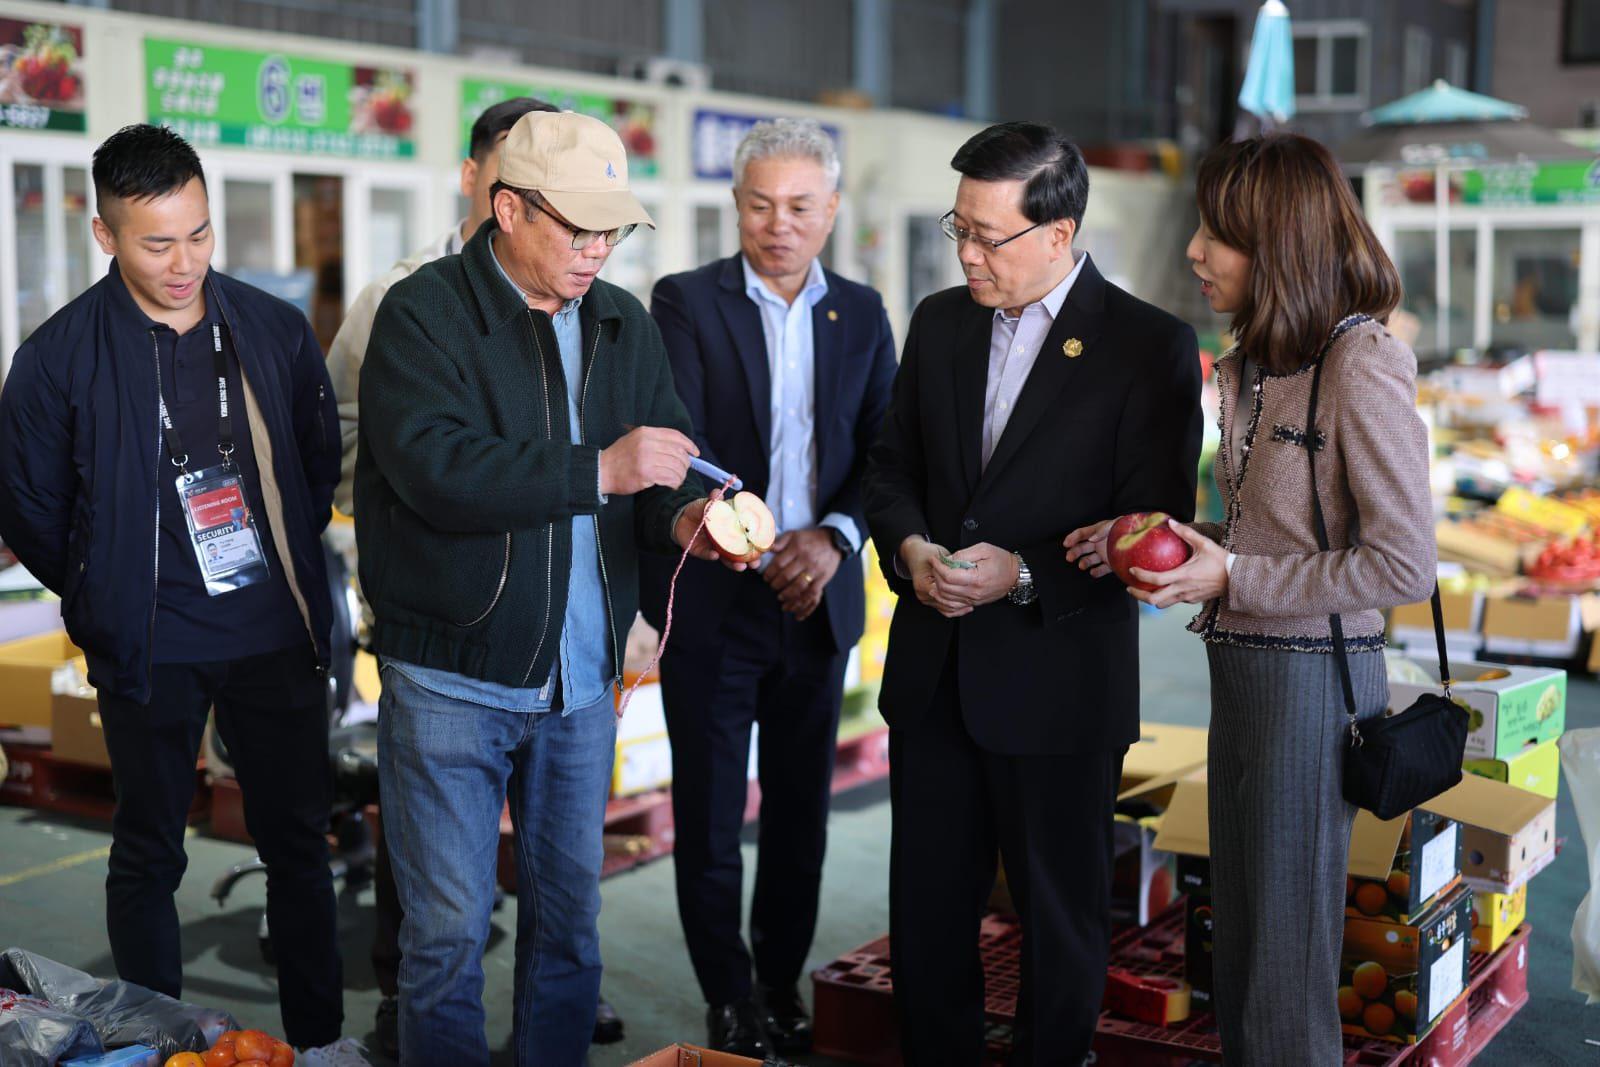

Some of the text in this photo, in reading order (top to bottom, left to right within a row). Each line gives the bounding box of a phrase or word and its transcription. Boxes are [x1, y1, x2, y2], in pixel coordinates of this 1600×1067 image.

[214, 337, 222, 352] KOREA
[220, 401, 229, 418] KOREA
[221, 495, 238, 504] ROOM
[197, 524, 235, 542] SECURITY
